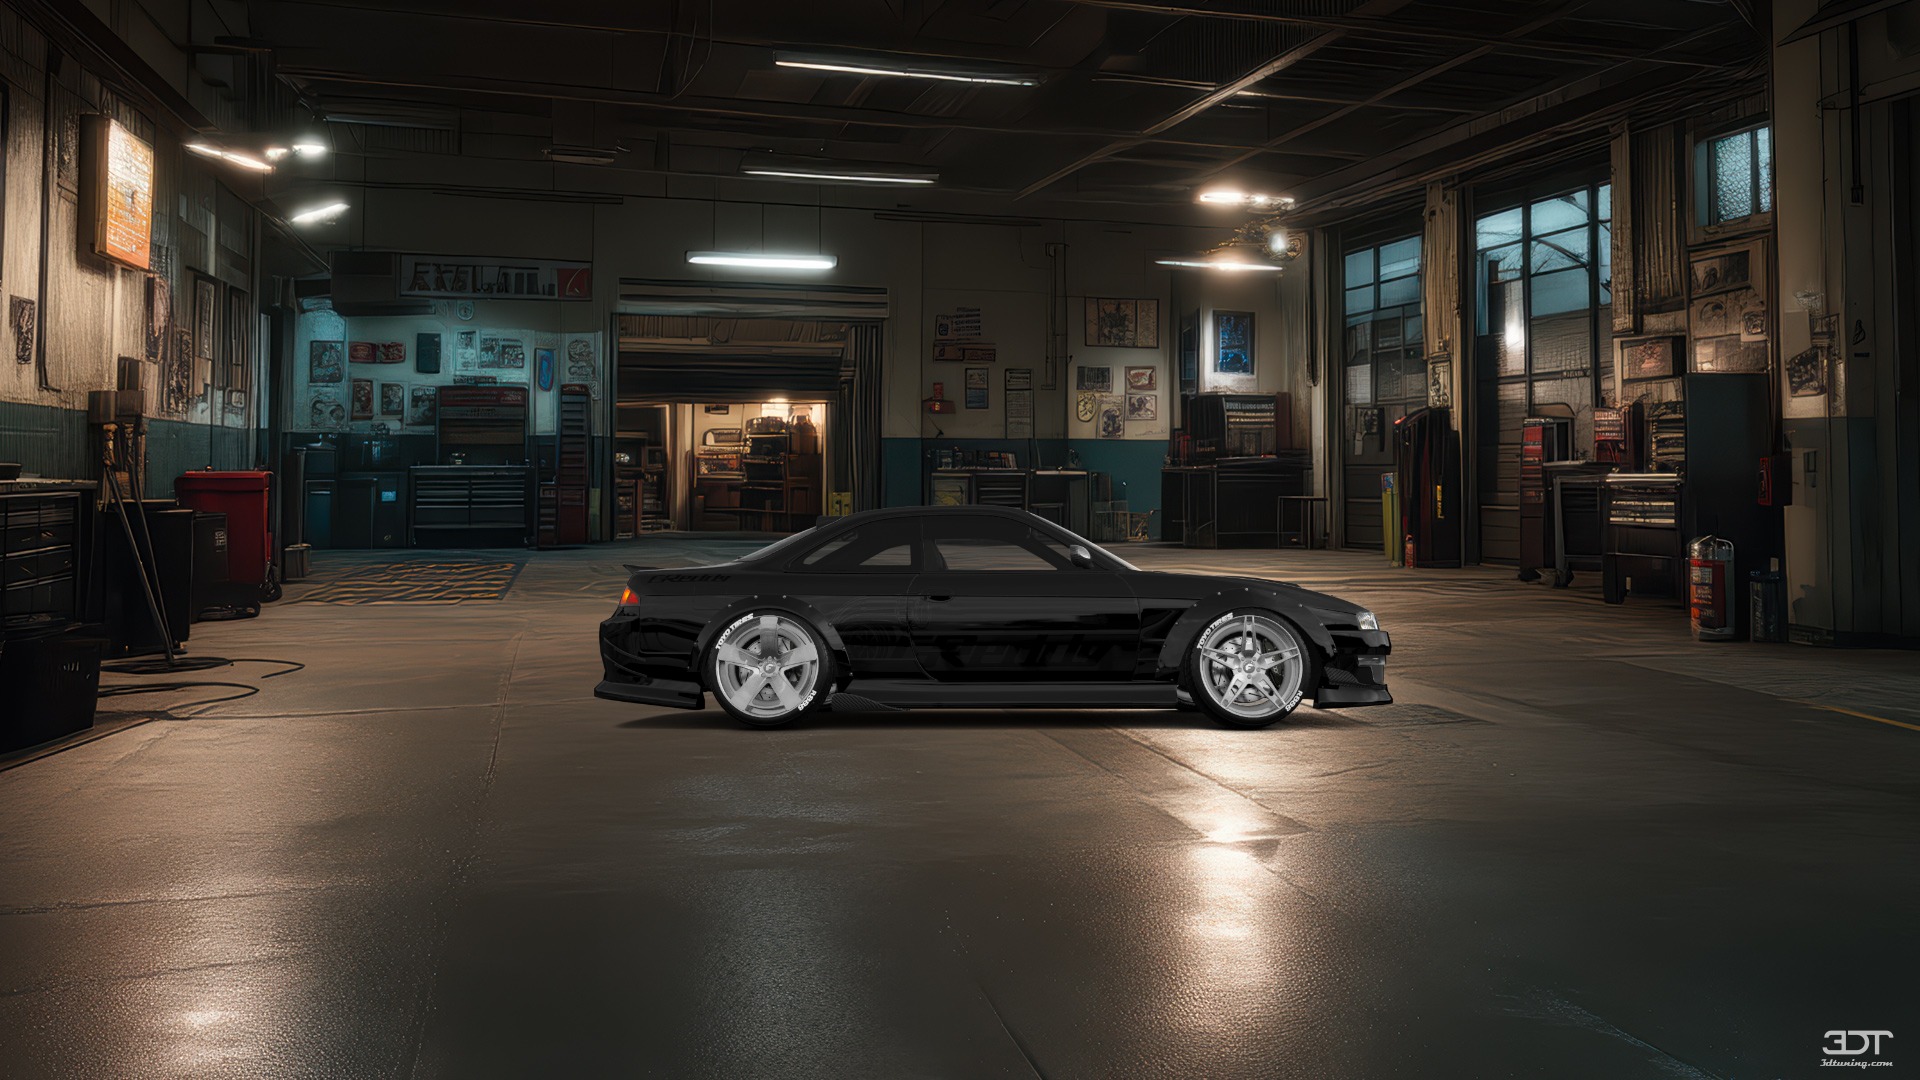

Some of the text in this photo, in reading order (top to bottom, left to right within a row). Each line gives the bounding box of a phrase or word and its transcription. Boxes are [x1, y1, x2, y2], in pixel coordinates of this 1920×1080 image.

[715, 612, 754, 650] TOYO TIRES
[1196, 612, 1234, 649] TOYO TIRES
